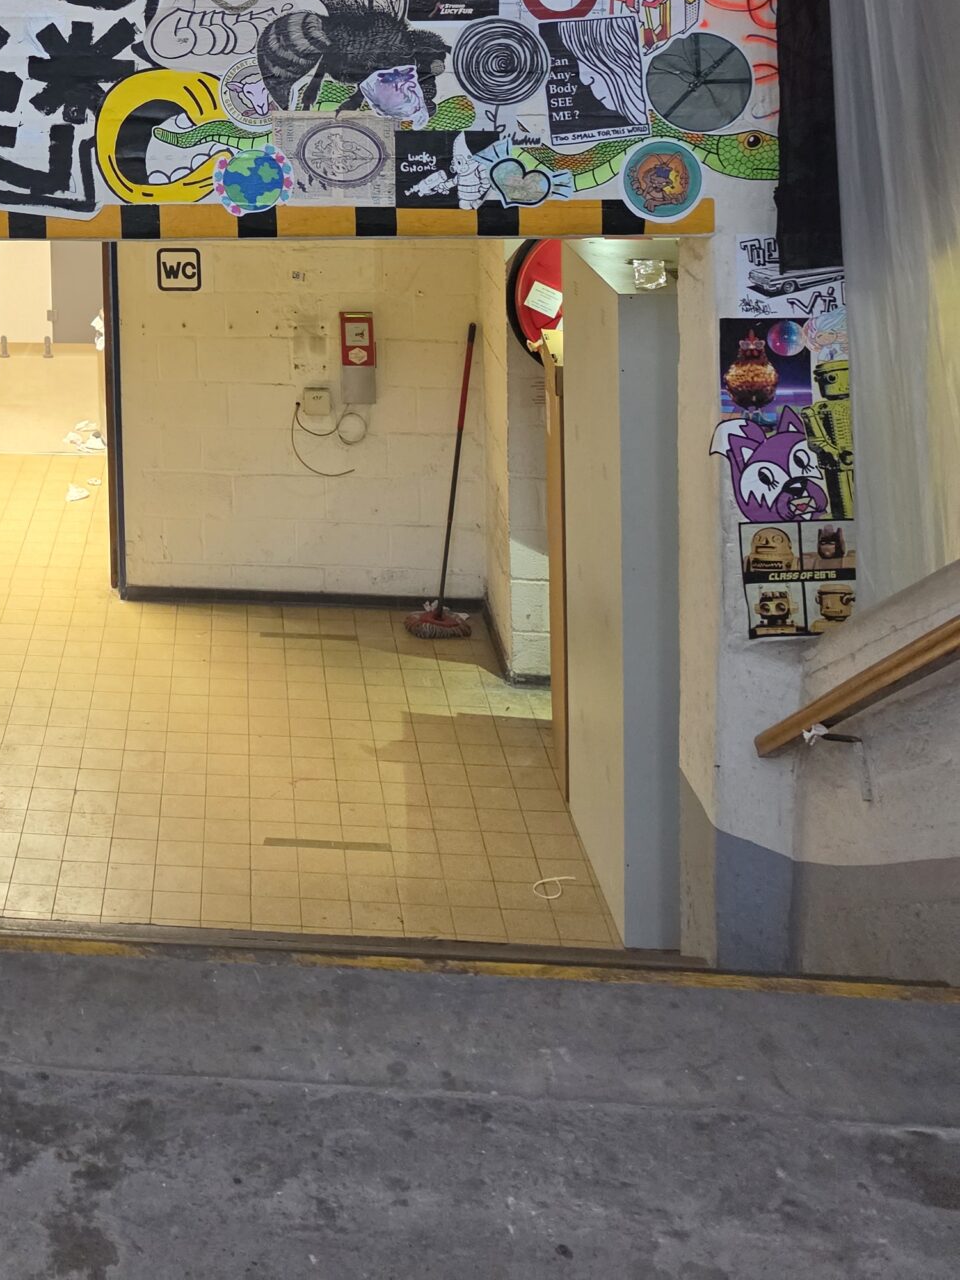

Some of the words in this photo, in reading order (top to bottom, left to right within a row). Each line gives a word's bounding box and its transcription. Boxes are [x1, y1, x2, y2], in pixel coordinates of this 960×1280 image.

[549, 71, 576, 82] Any-
[549, 83, 578, 96] Body
[550, 97, 574, 108] SEE
[571, 132, 596, 141] SMALL
[596, 129, 612, 138] FOR
[627, 124, 649, 134] WORLD
[740, 237, 780, 266] THE
[162, 261, 197, 280] WC
[768, 571, 800, 581] CLASS
[800, 571, 814, 580] OF
